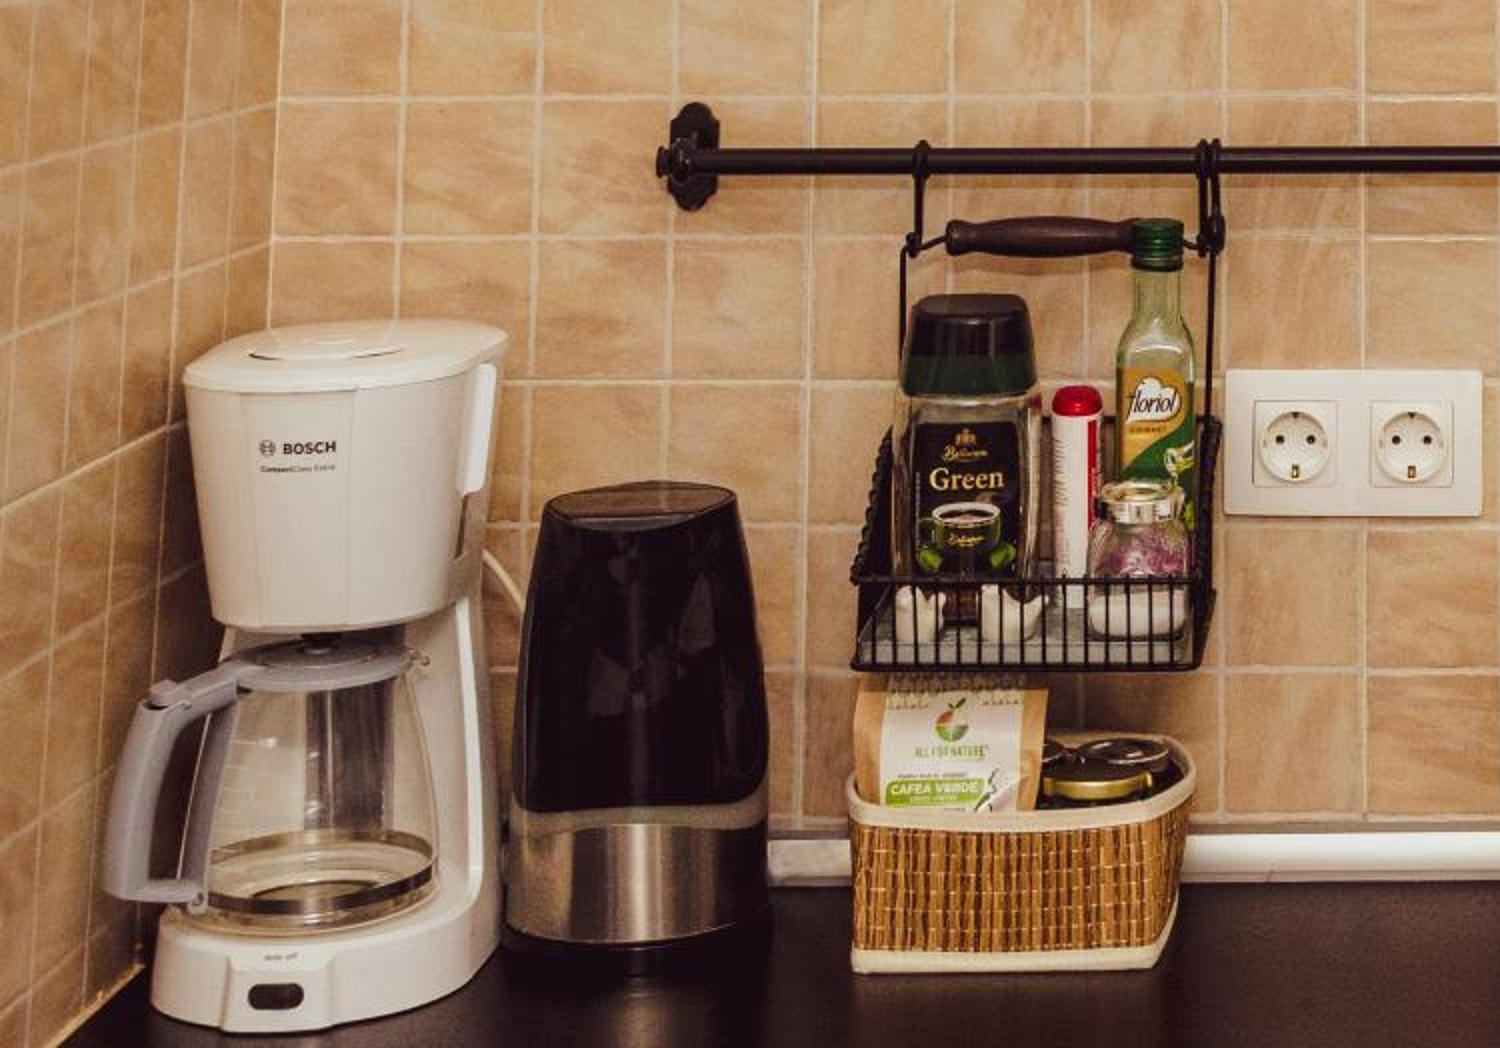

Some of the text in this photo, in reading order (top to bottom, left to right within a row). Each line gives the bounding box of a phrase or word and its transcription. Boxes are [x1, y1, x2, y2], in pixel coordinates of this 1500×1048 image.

[1125, 385, 1177, 419] floriol
[283, 440, 336, 454] BOSCH
[929, 467, 1004, 490] Green
[891, 782, 978, 795] CAFEA VERDE
